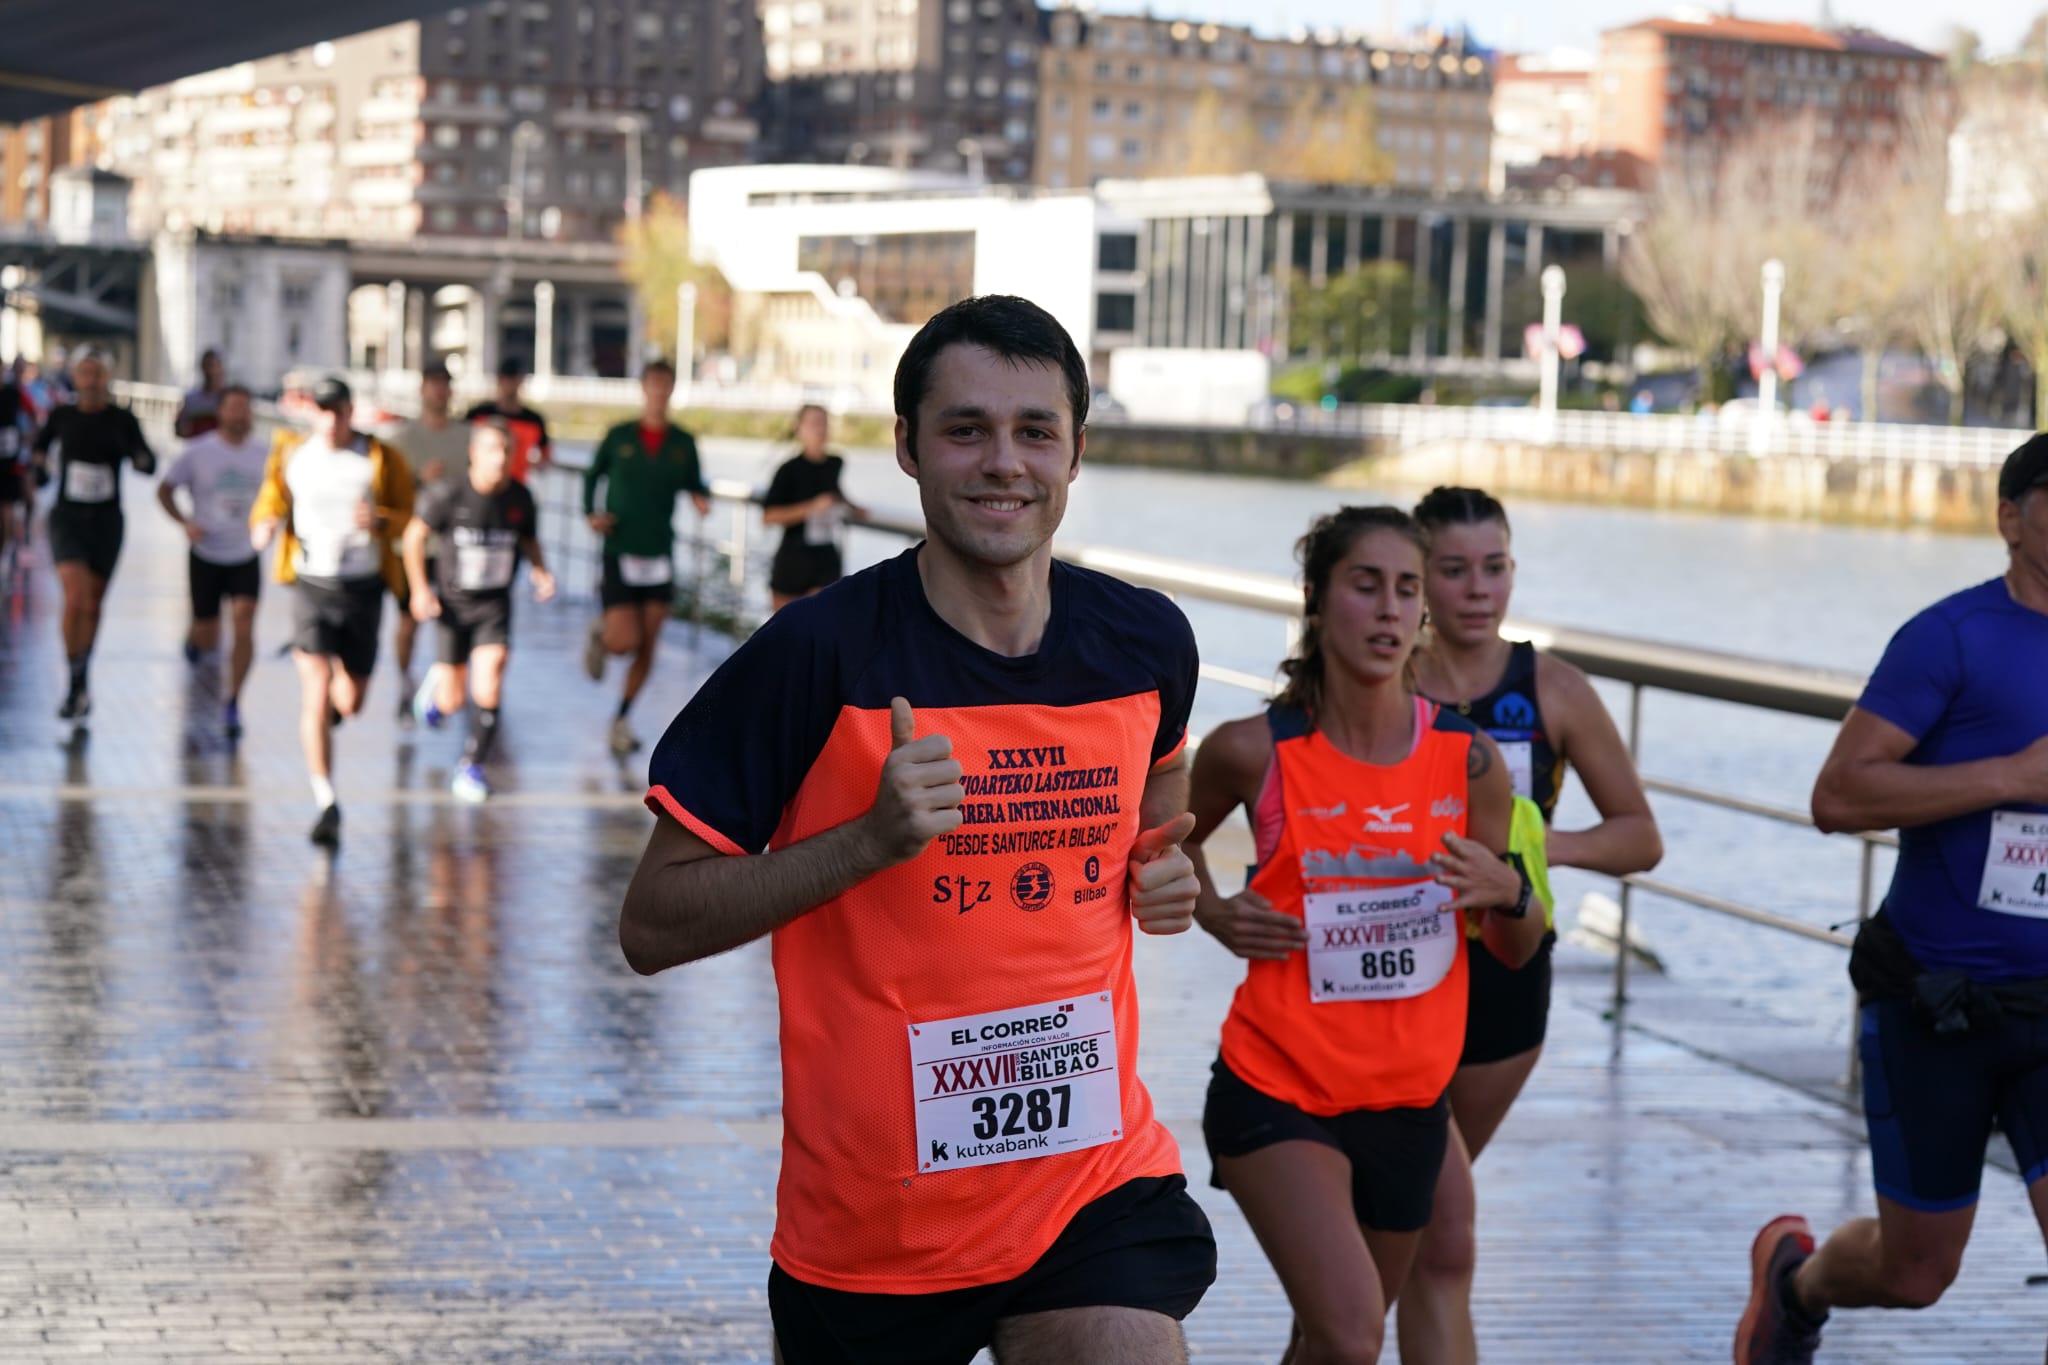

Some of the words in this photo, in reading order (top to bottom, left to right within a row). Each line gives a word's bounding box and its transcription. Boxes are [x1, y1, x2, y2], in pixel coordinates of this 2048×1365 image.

[988, 746, 1066, 769] XXXVII
[1034, 766, 1118, 793] LASTERKETA
[1007, 794, 1120, 822] INTERNACIONAL
[992, 830, 1056, 854] SANTURCE
[1057, 829, 1067, 848] A
[1074, 886, 1107, 905] Bilbao
[2032, 871, 2048, 897] 4
[1336, 903, 1356, 915] EL
[1357, 896, 1422, 914] CORREO
[1360, 947, 1416, 980] 866
[951, 1029, 978, 1046] EL
[980, 1013, 1068, 1041] CORREO
[1031, 1036, 1047, 1046] CON
[1047, 1032, 1070, 1042] VALOR
[1020, 1038, 1098, 1065] SANTURCE
[932, 1053, 1017, 1095] XXXVII
[971, 1084, 1072, 1140] 3287
[956, 1133, 1049, 1160] kutxabank
